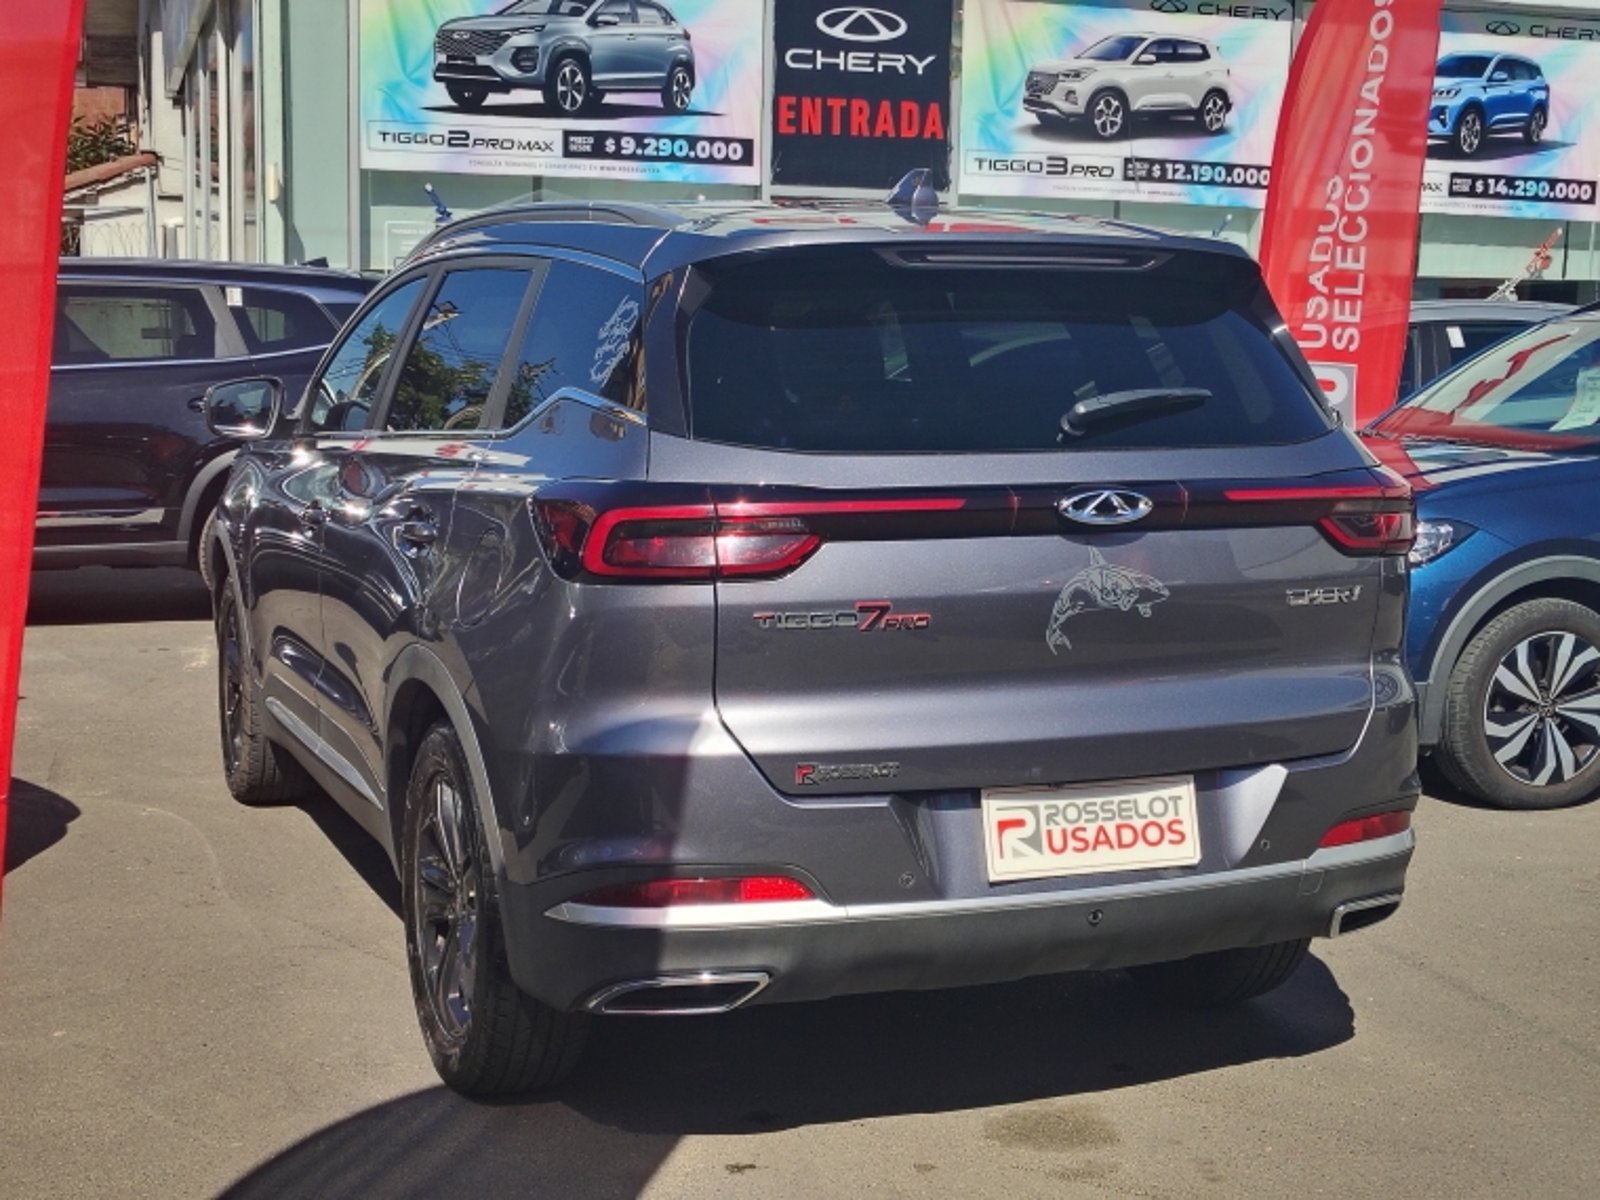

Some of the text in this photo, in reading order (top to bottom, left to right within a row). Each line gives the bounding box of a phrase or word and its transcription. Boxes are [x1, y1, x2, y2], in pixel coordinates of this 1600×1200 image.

[1197, 3, 1287, 21] CHERY
[784, 48, 936, 75] CHERY
[778, 95, 945, 140] ENTRADA
[516, 140, 555, 152] MAX
[620, 136, 744, 161] 9.290.000
[1165, 163, 1271, 186] 12.190.000
[1332, 0, 1394, 352] SELECCIONADO
[1487, 178, 1593, 200] 14.290.000
[1044, 796, 1183, 827] ROSSELOT
[1046, 819, 1187, 855] USADOS
